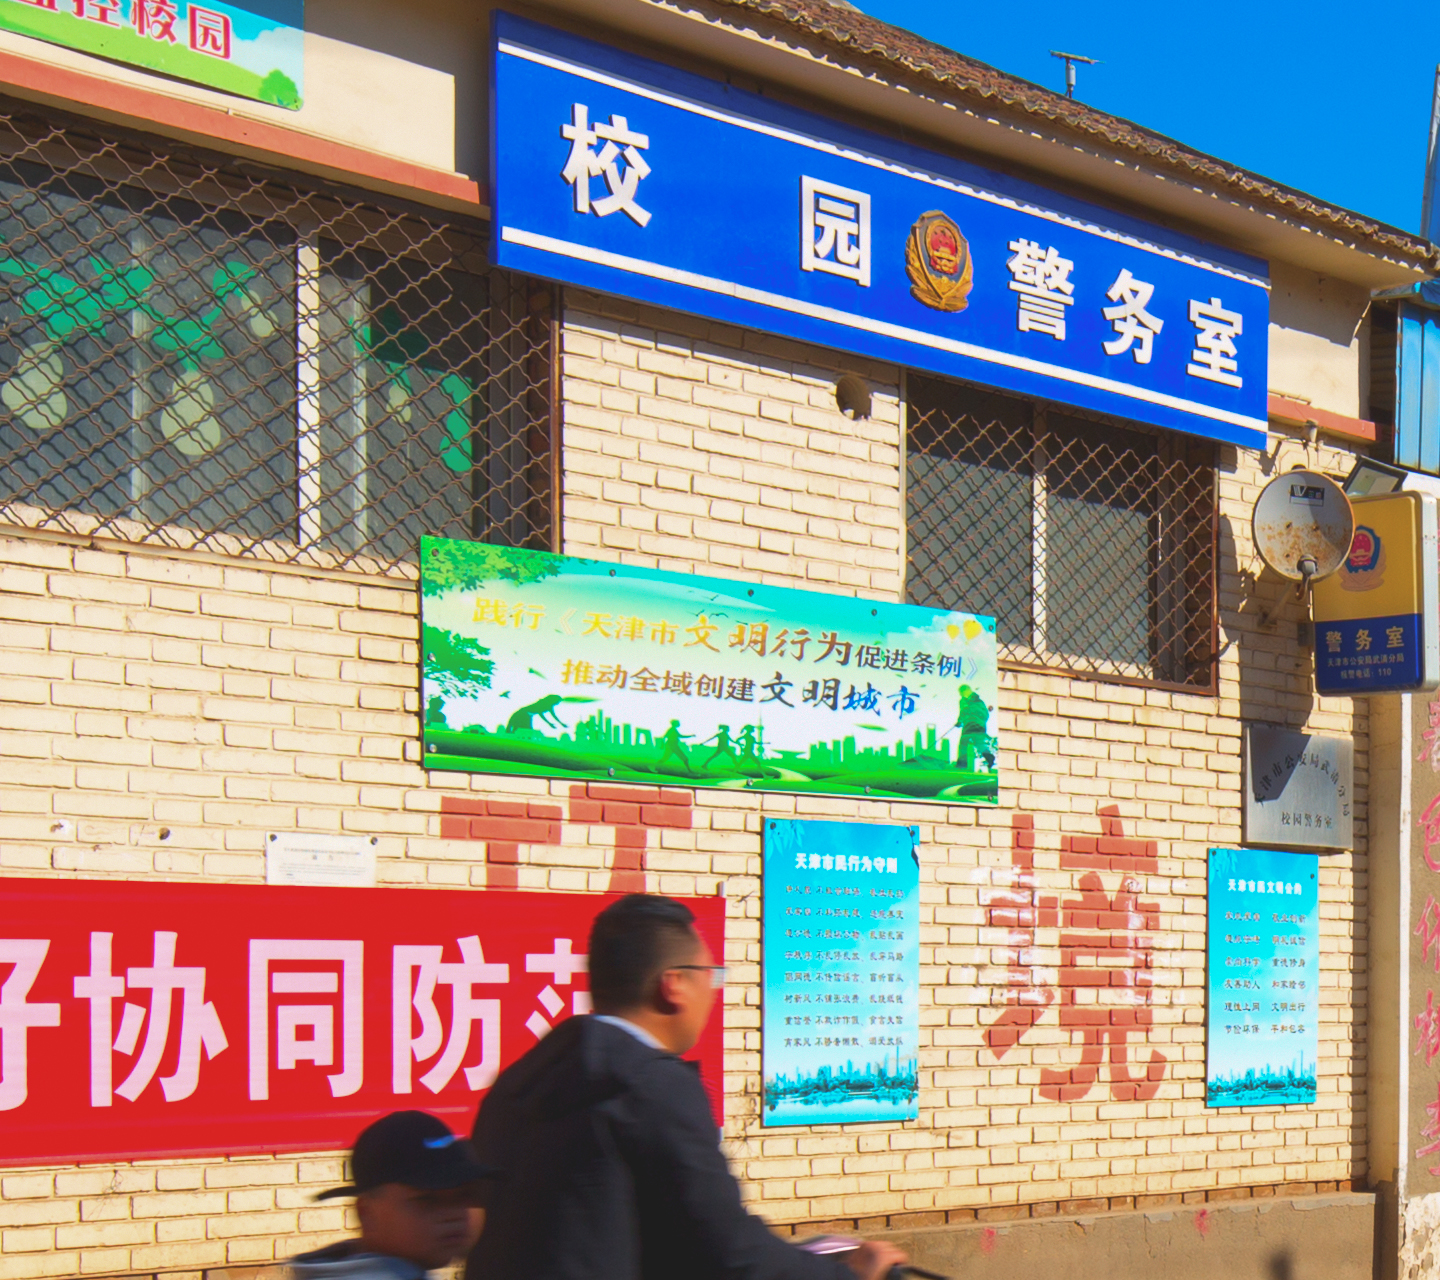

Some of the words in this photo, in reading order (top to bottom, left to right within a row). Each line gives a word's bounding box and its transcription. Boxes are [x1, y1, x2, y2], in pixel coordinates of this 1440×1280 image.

[561, 103, 1244, 389] 校园警务室
[471, 596, 980, 681] 践行《天津市文明行为促进条例》
[1326, 625, 1405, 653] 警务室
[1327, 652, 1405, 667] 天津市公安局武清分局
[560, 657, 922, 720] 推动全域创建文明城市
[1281, 811, 1333, 829] 校园警务室
[794, 852, 899, 874] 天津市民行为守则
[1227, 878, 1303, 896] 天津市民文明公约
